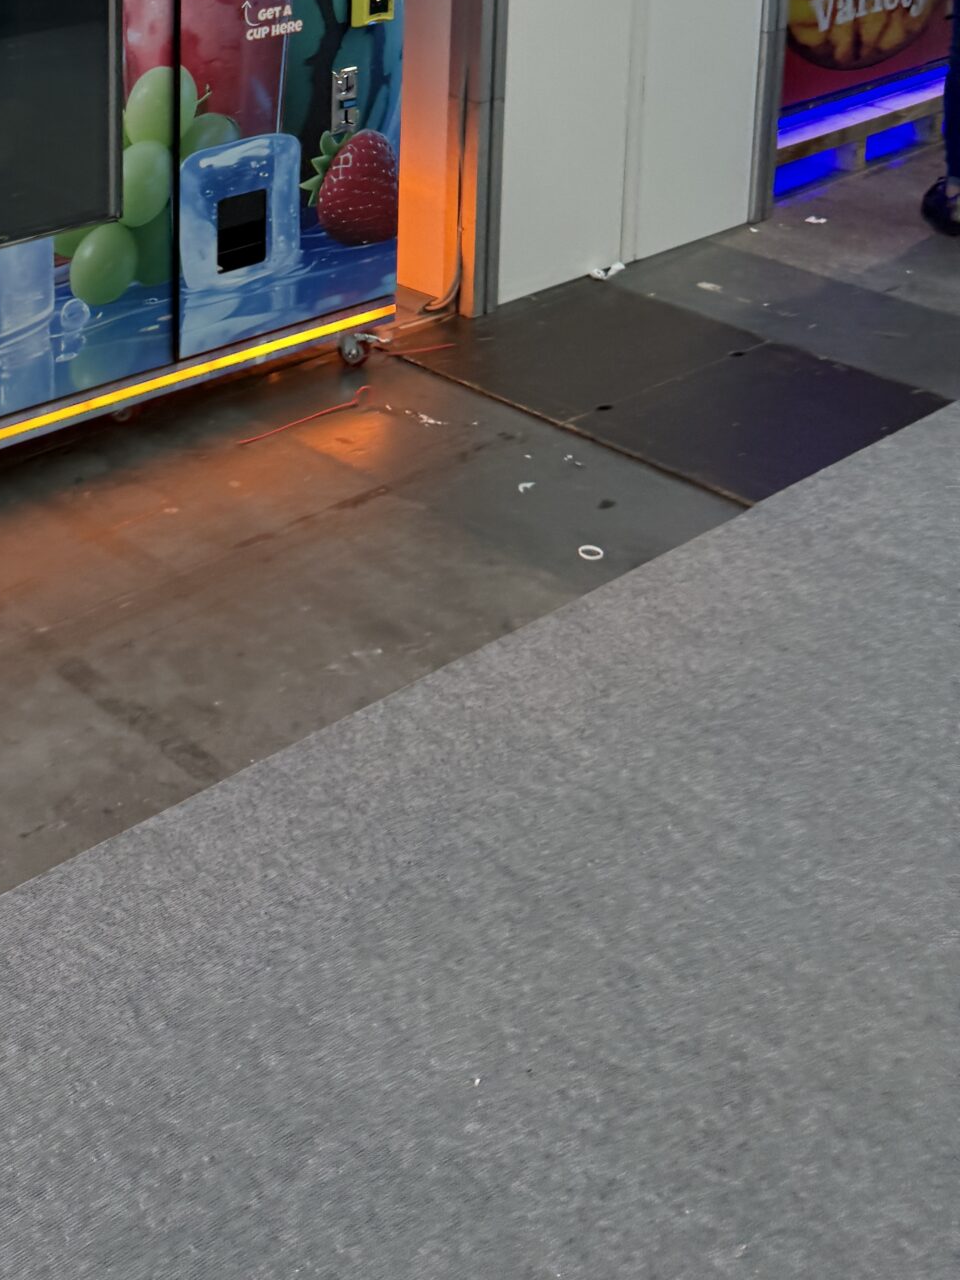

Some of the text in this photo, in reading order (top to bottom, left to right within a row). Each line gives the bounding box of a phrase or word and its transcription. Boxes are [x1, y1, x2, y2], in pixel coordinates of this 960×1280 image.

[257, 4, 293, 21] GET A
[246, 19, 304, 41] CUP HERE
